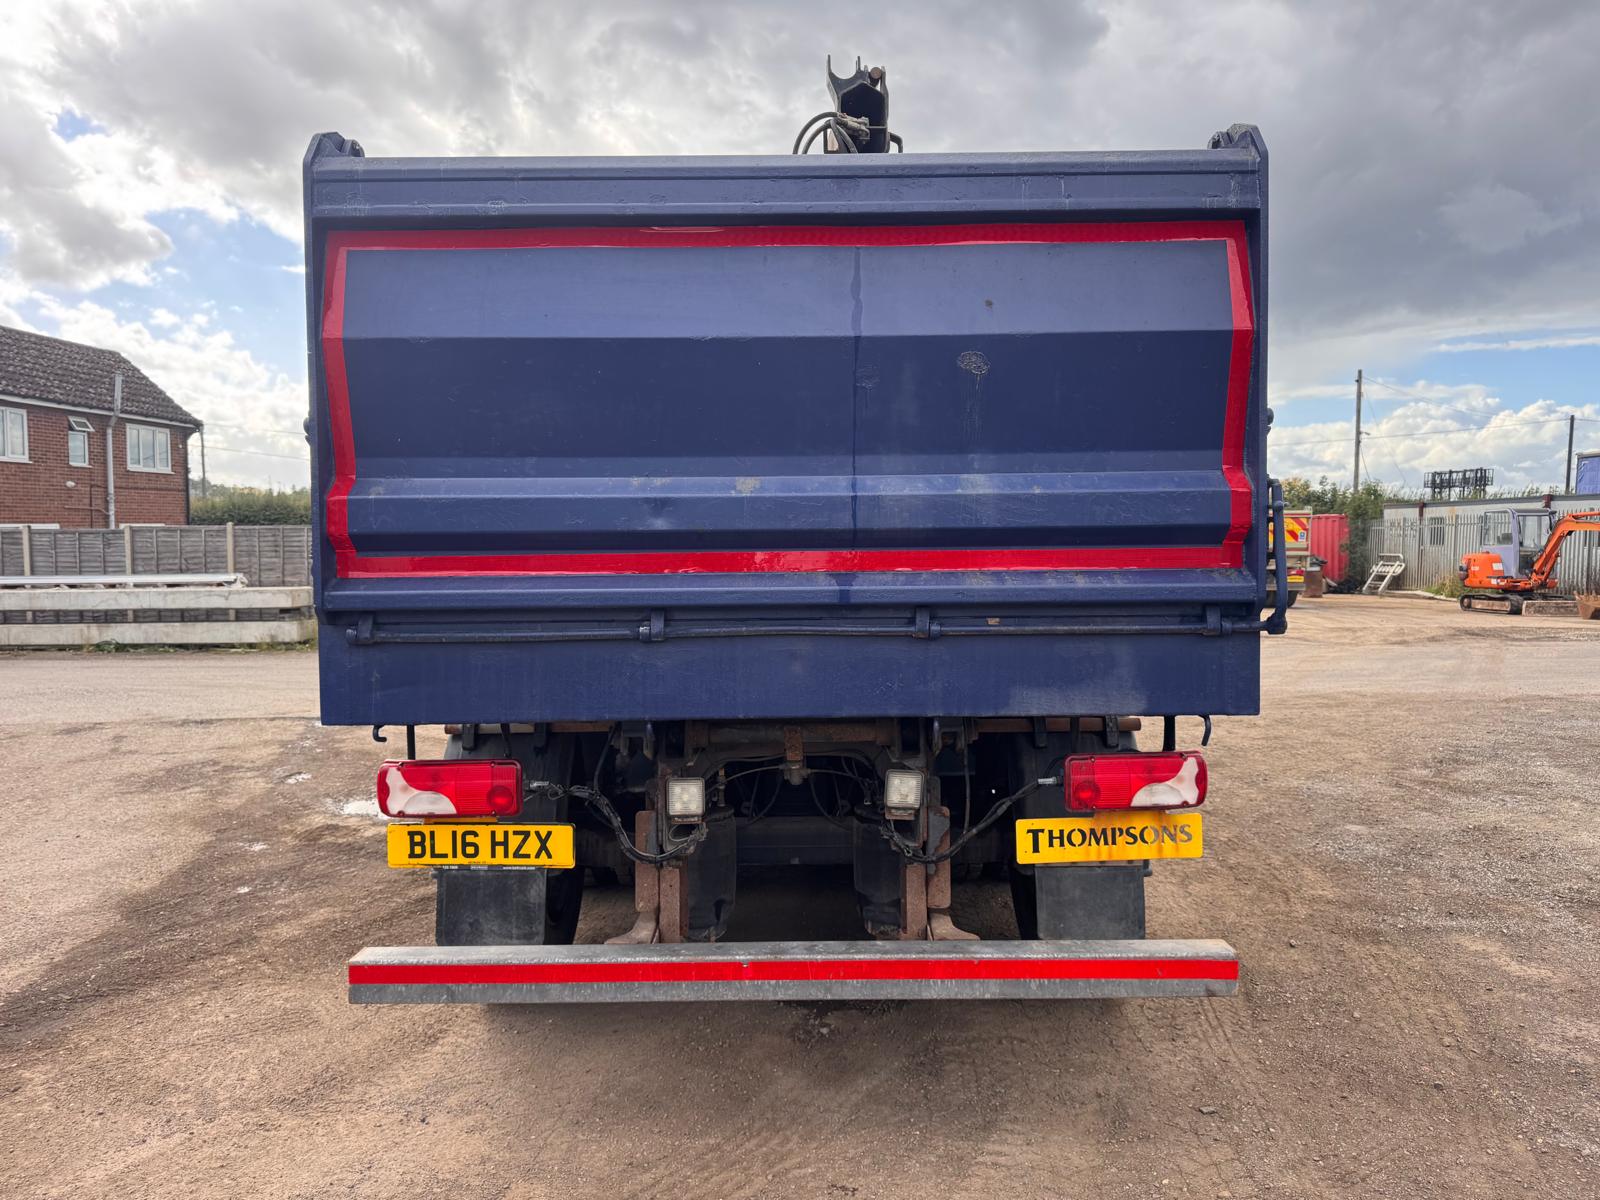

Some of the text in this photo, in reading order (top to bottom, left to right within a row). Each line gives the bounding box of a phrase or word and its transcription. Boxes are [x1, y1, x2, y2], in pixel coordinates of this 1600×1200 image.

[407, 830, 553, 859] BL16 HZX
[1026, 824, 1193, 853] THOMPSONS
